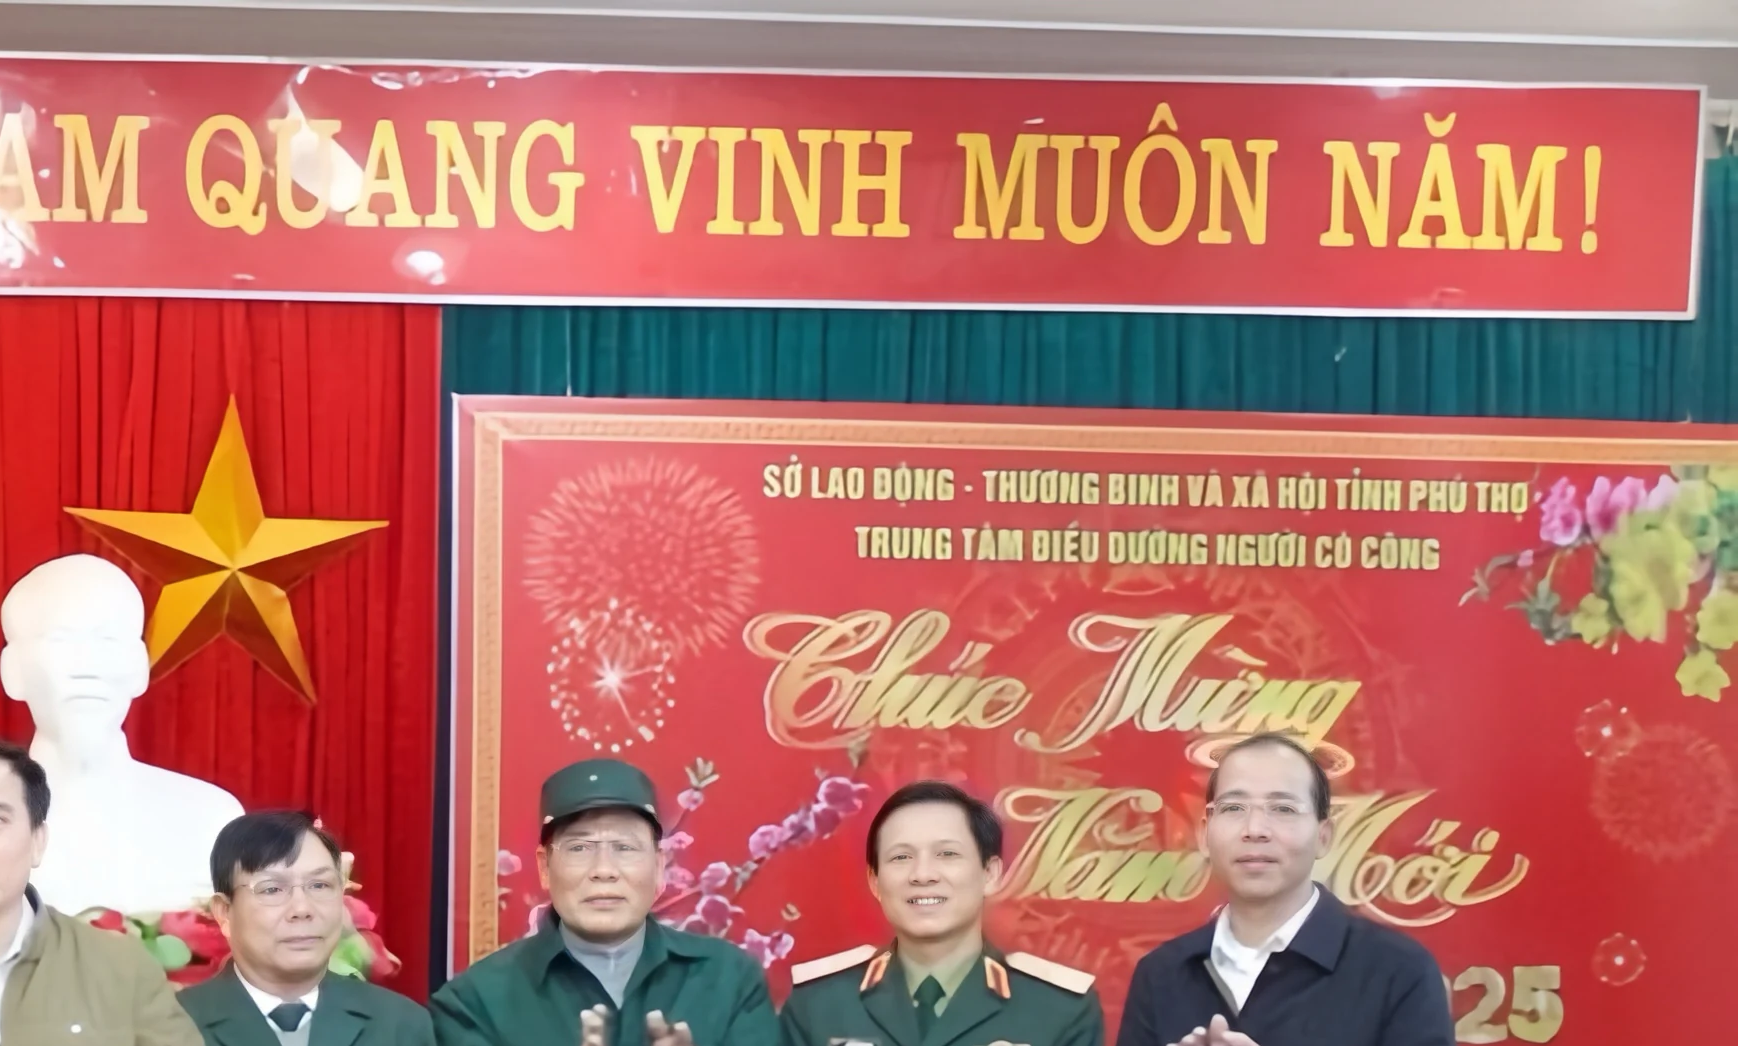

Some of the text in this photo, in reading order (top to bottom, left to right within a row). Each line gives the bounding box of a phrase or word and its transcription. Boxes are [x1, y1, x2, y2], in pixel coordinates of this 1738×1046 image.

[184, 113, 586, 236] QUANG
[630, 124, 914, 238] VINH
[952, 102, 1279, 246] MUÔN
[1319, 111, 1603, 254] NĂM!
[763, 454, 802, 498] SỞ
[811, 466, 865, 500] LAO
[873, 461, 955, 507] ĐỘNG
[982, 469, 1100, 504] THƯƠNG
[1108, 473, 1180, 506] BINH
[1278, 471, 1327, 516] HỘI
[1334, 467, 1402, 511] TỈNH
[1408, 473, 1468, 513] PHÚ
[1474, 481, 1529, 522] THỌ
[854, 526, 952, 560] TRUNG
[961, 521, 1024, 561] TÂM
[1108, 524, 1208, 565] DƯỠNG
[1216, 527, 1307, 567] NGƯỜI
[1315, 530, 1352, 568] CÓ
[1361, 531, 1440, 570] CÔNG
[742, 608, 1361, 779] Chúc Mừng
[994, 787, 1531, 928] Năm Mới
